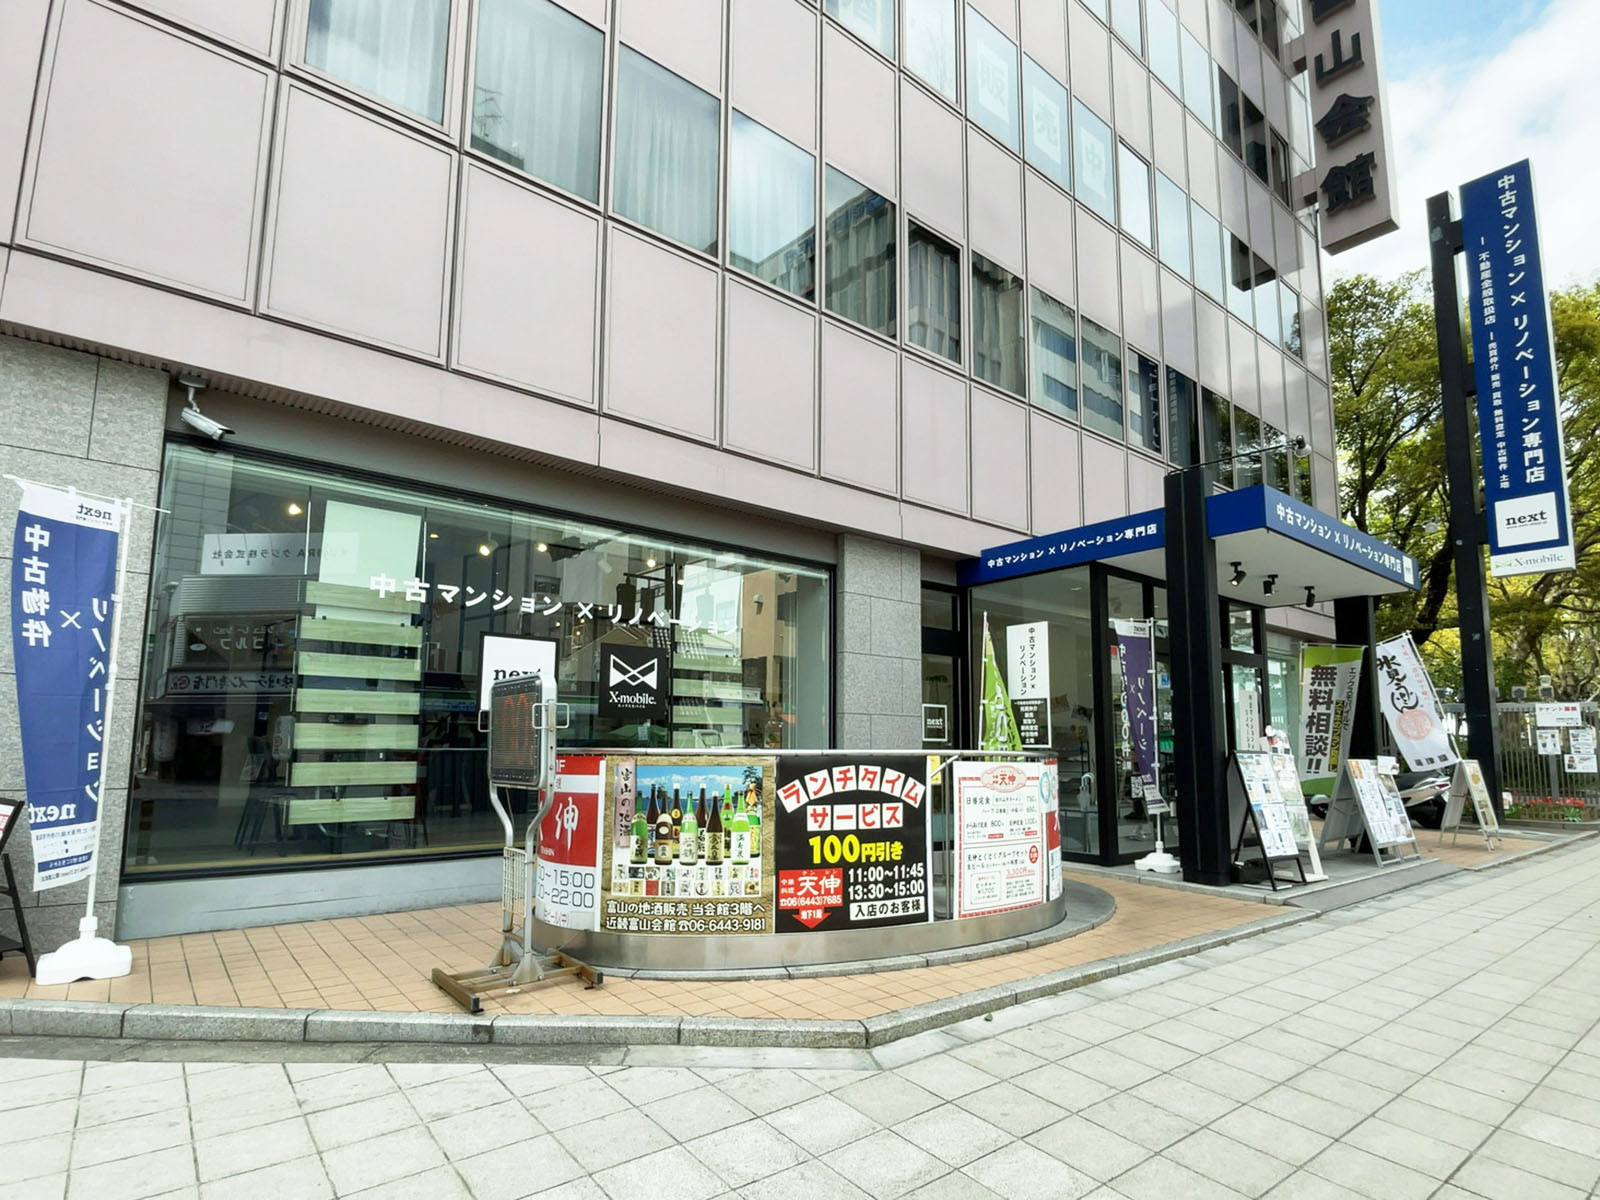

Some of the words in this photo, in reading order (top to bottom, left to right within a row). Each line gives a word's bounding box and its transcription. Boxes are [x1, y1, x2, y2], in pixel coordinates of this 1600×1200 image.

[1497, 174, 1526, 286] 中古マンション
[1513, 314, 1546, 484] リノベーション専門店
[1505, 510, 1548, 526] next
[987, 549, 1044, 569] 中古マンション
[1060, 523, 1158, 553] リノベーション専門店
[1276, 502, 1331, 540] 中古マンション
[1343, 534, 1402, 574] リノベーション専門店
[369, 573, 563, 616] 中古マンション
[608, 603, 739, 635] リノベーション
[1019, 644, 1028, 696] リノベーション
[1028, 627, 1037, 681] 中古マンション
[1305, 665, 1338, 775] 無料相談!!
[782, 768, 919, 806] ランチタイム
[810, 806, 901, 829] サービス
[808, 833, 904, 864] 100円引き
[797, 874, 842, 896] 天伸
[606, 900, 688, 916] 富山の地酒販売
[692, 902, 765, 917] 当会館3階へ
[606, 917, 677, 931] 近畿富山会館
[688, 918, 766, 931] 06-6443-9181
[855, 899, 922, 919] 入店のお客様
